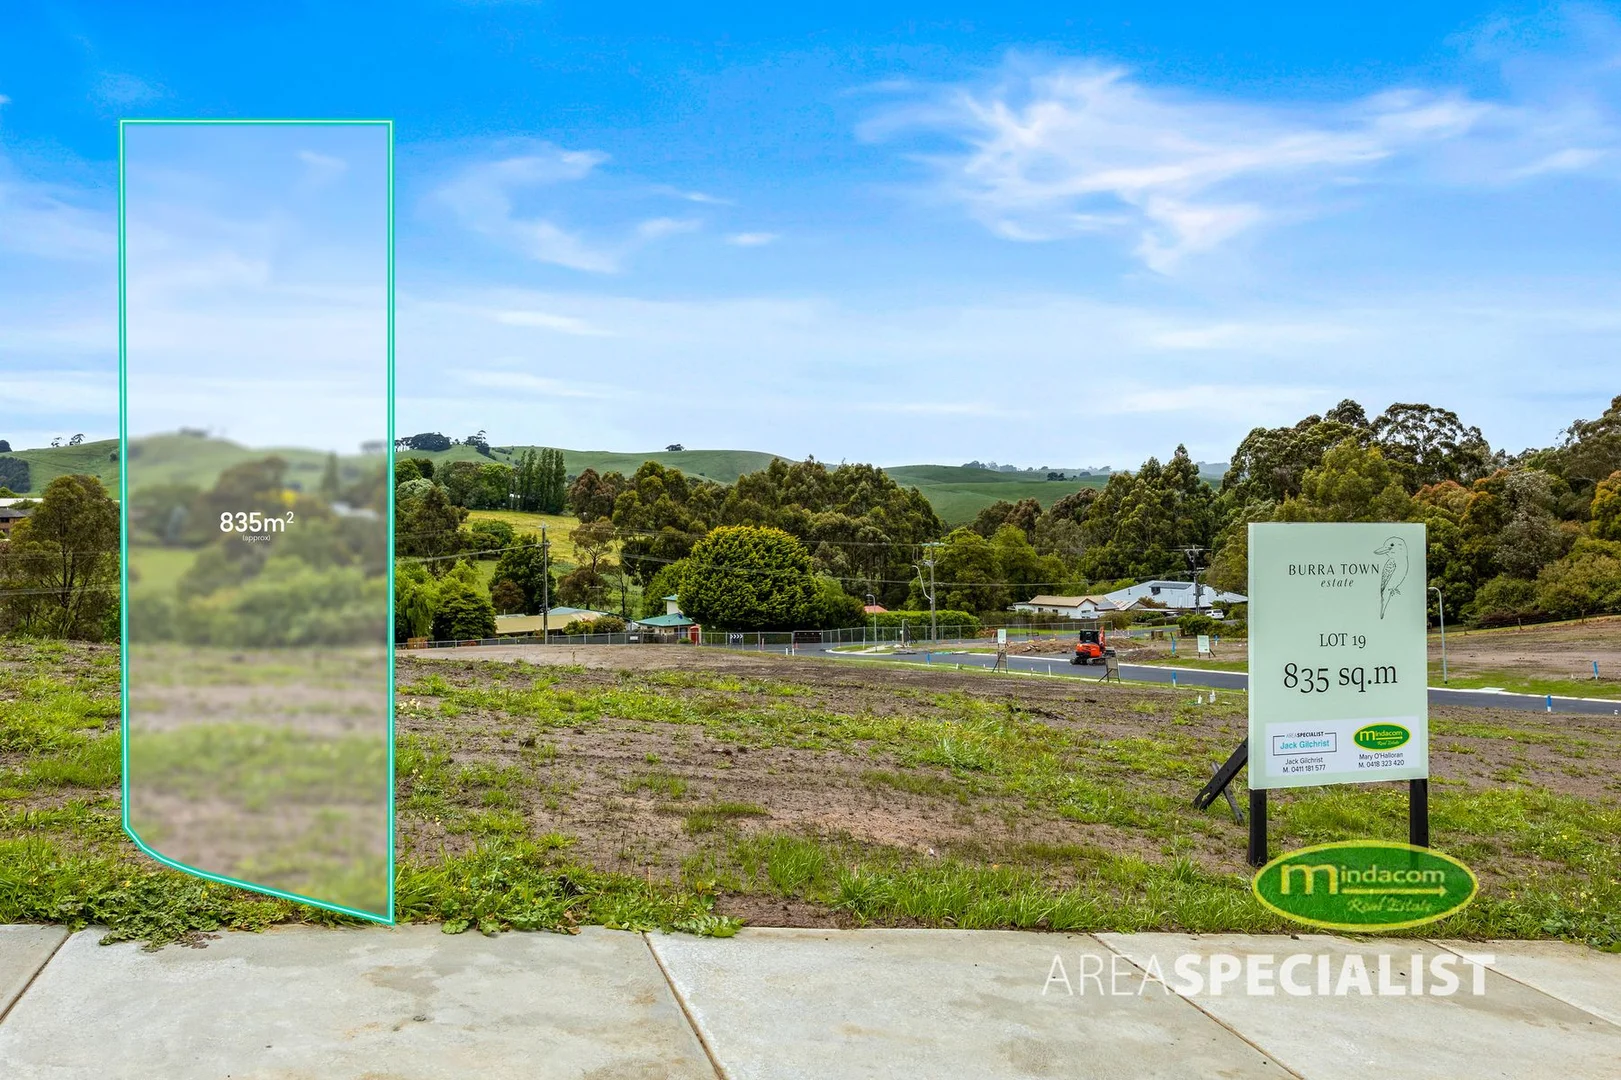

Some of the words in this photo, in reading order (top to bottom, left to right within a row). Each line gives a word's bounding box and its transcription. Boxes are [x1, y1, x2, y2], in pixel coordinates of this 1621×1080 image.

[1289, 564, 1335, 575] BURRA
[1340, 563, 1380, 575] TOWN
[1320, 577, 1354, 588] estate
[1320, 633, 1348, 647] LOT
[1352, 635, 1367, 649] 19
[1283, 662, 1329, 693] 835
[1338, 664, 1398, 693] sq.m
[1280, 742, 1297, 750] Jack
[1299, 740, 1330, 748] Gilchrist
[1359, 753, 1373, 761] Mary
[1291, 765, 1304, 773] 0411
[1315, 764, 1326, 772] 577
